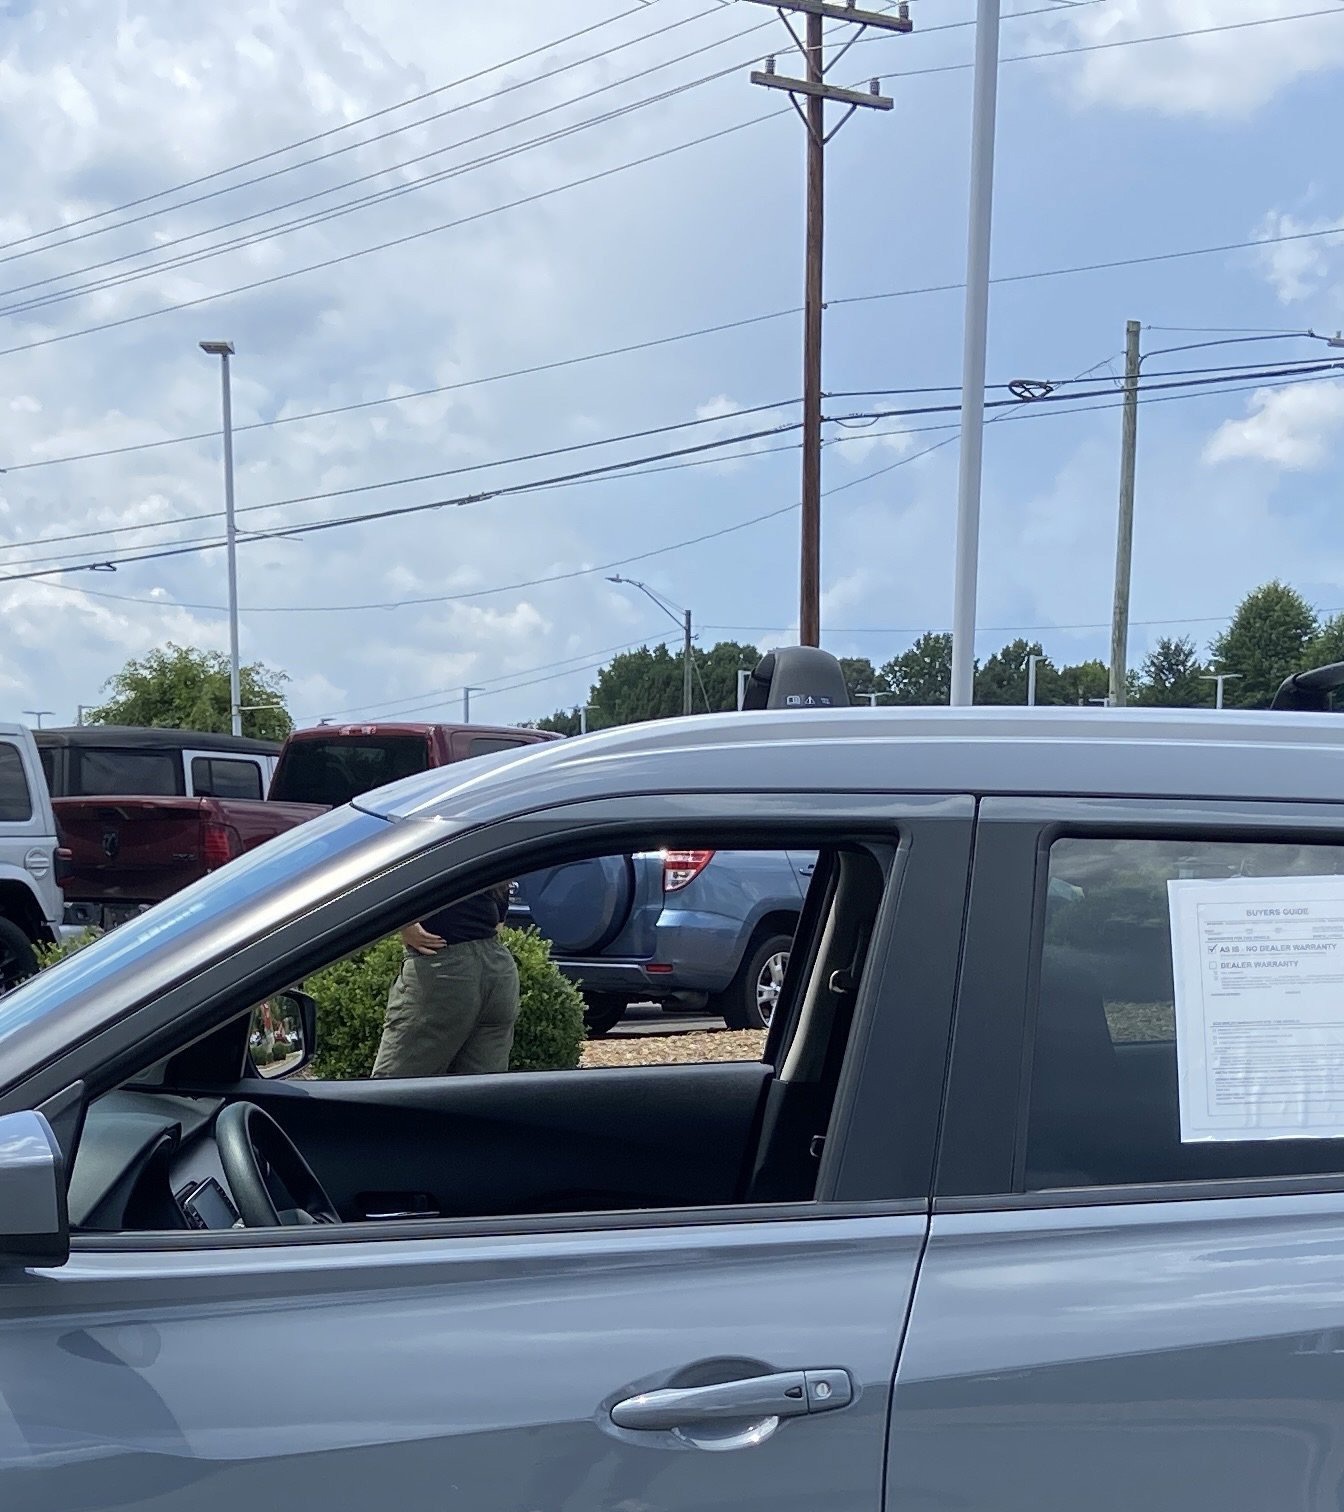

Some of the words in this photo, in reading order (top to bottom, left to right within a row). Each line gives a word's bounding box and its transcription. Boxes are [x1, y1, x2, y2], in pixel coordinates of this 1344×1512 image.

[1246, 908, 1281, 917] BUYERS
[1282, 907, 1310, 916] GUIDE
[1246, 945, 1258, 953] NO
[1259, 944, 1292, 952] DEALER
[1293, 943, 1337, 951] WARRANTY
[1220, 961, 1253, 969] DEALER
[1254, 960, 1299, 969] WARRANTY
